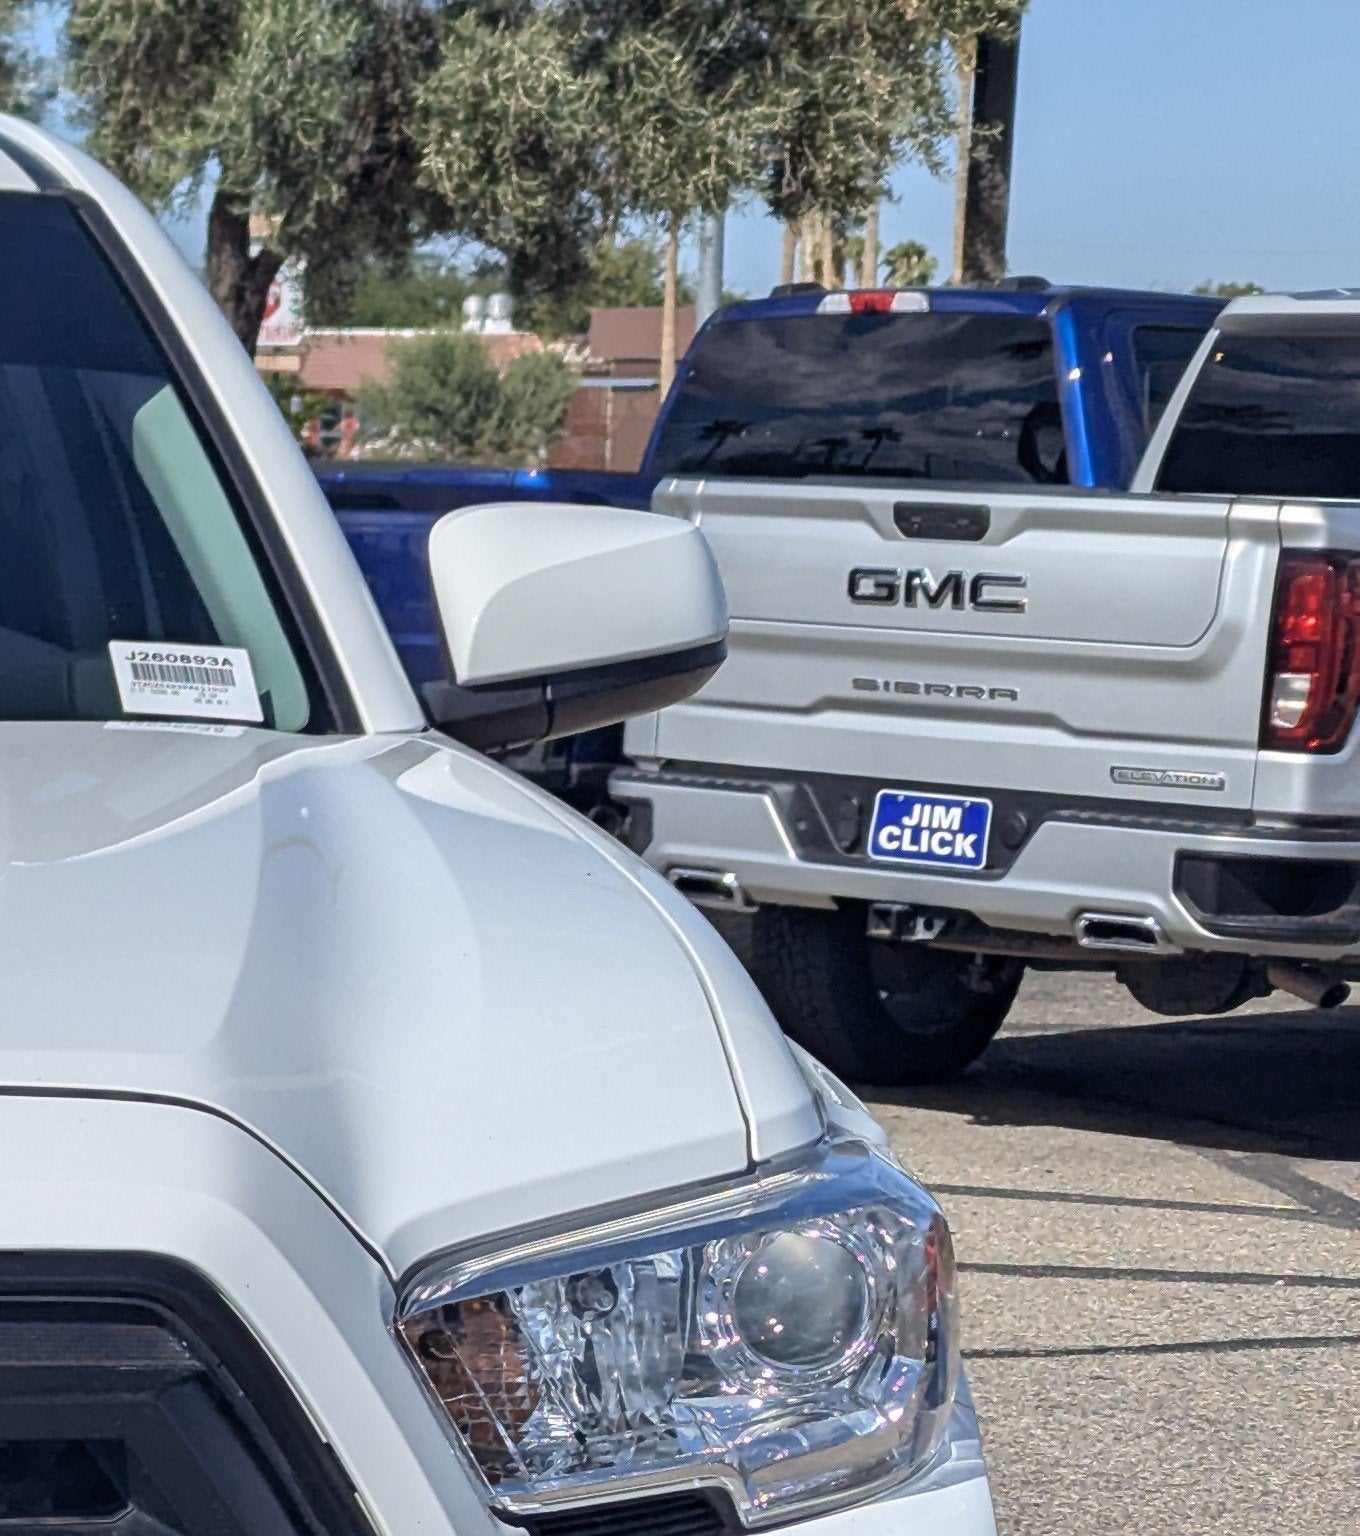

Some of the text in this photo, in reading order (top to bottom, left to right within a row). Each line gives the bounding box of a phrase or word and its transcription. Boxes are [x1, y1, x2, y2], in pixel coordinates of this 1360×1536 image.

[847, 566, 1028, 614] GMC
[124, 651, 234, 667] J260893A
[851, 677, 1019, 701] SIERRA
[1117, 769, 1220, 786] ELEVATION
[901, 803, 963, 831] JIM
[878, 825, 978, 858] CLICK
